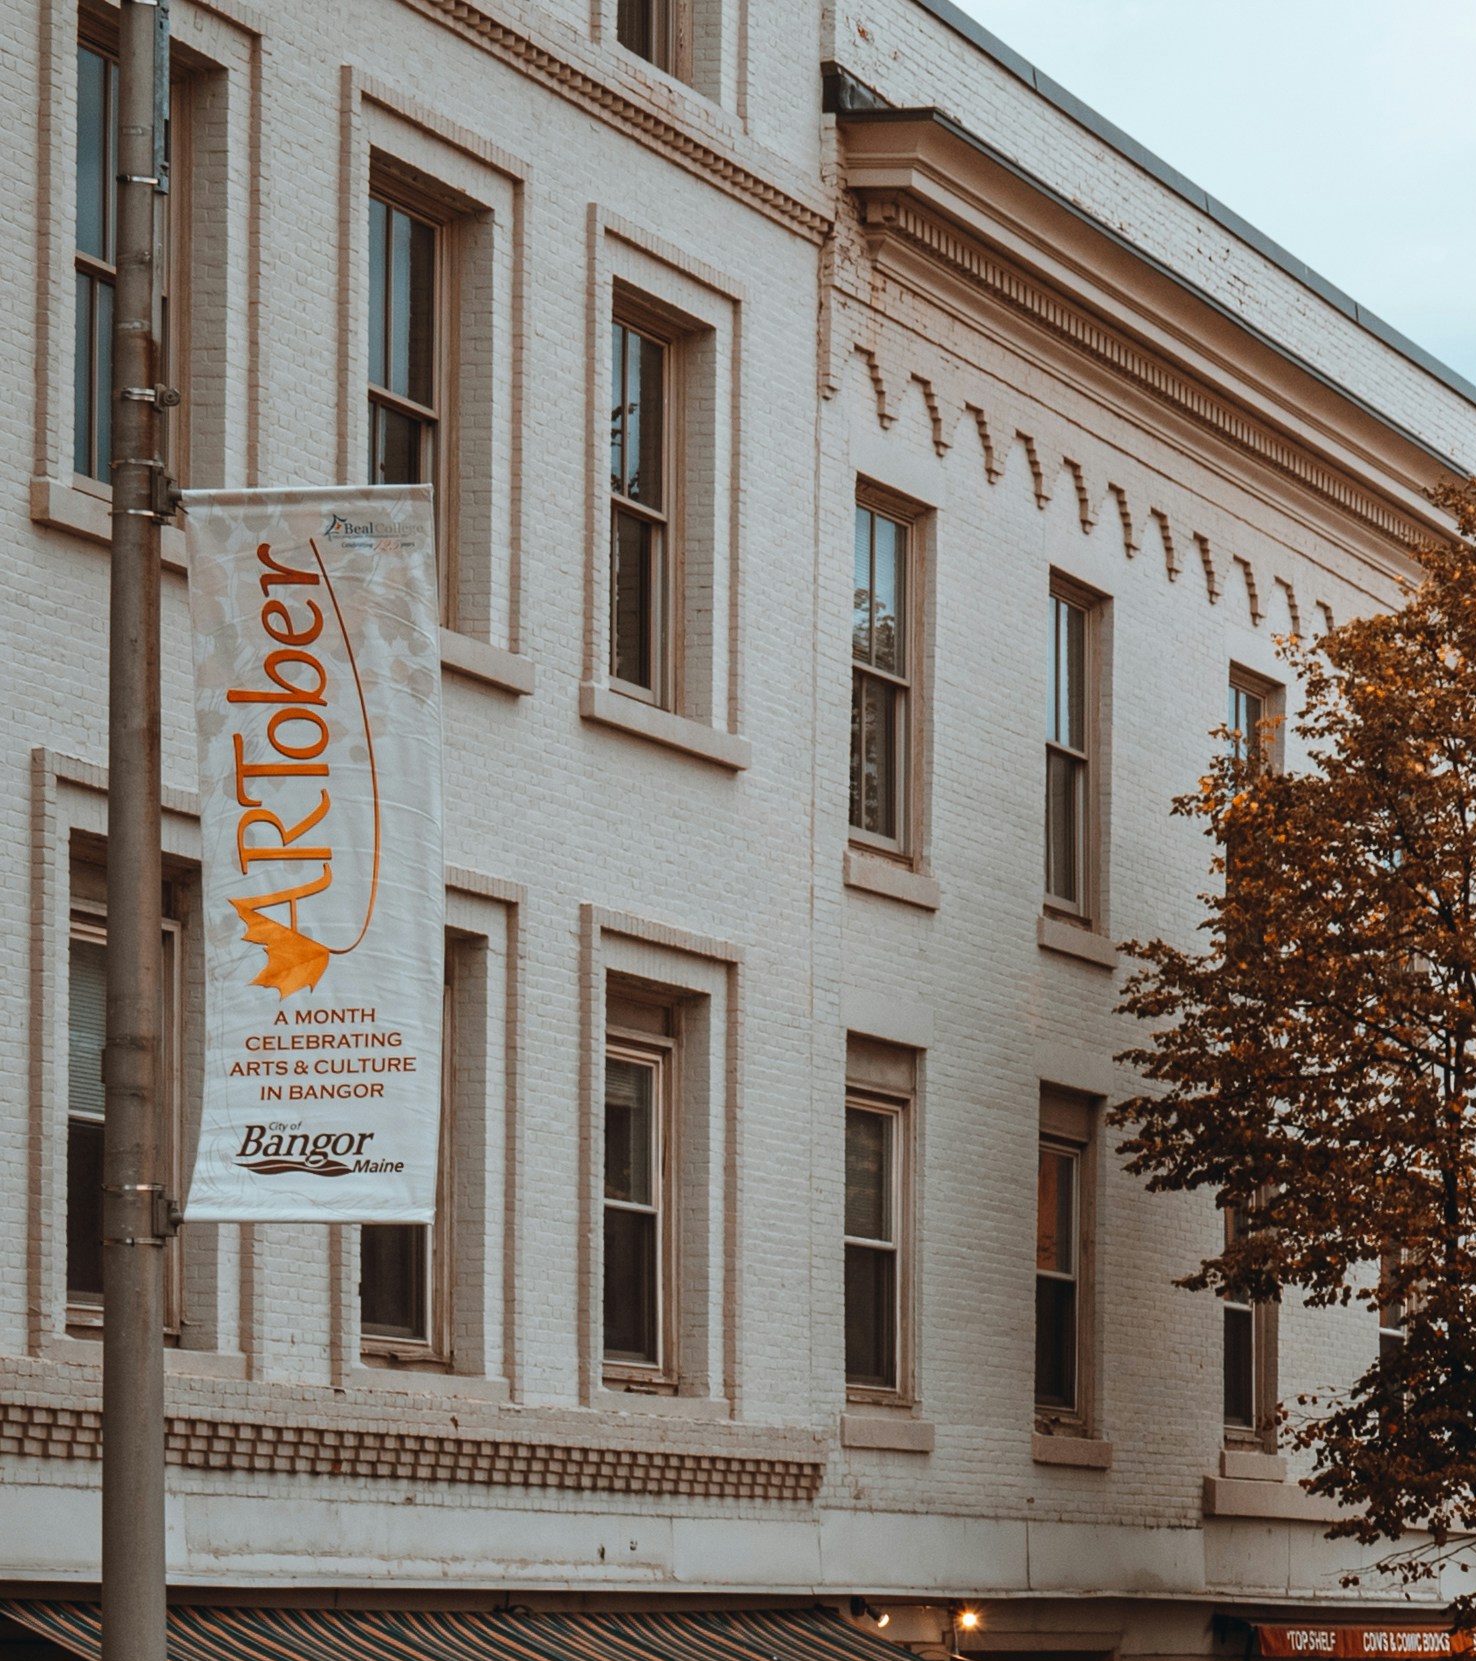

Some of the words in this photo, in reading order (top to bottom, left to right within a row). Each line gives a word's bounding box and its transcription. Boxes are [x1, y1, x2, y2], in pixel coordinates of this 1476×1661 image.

[344, 522, 373, 534] Beal
[227, 541, 333, 958] ARTober
[274, 1011, 288, 1025] A
[295, 1008, 376, 1024] MONTH
[245, 1032, 402, 1051] CELEBRATING
[230, 1061, 288, 1077] ARTS
[294, 1060, 309, 1075] &
[315, 1057, 416, 1075] CULTURE
[260, 1086, 282, 1100] IN
[289, 1083, 385, 1100] BANGOR
[268, 1121, 288, 1132] City
[290, 1121, 303, 1130] of
[236, 1125, 375, 1165] Bangor
[352, 1158, 404, 1173] Maine
[1309, 1631, 1336, 1651] SHELF
